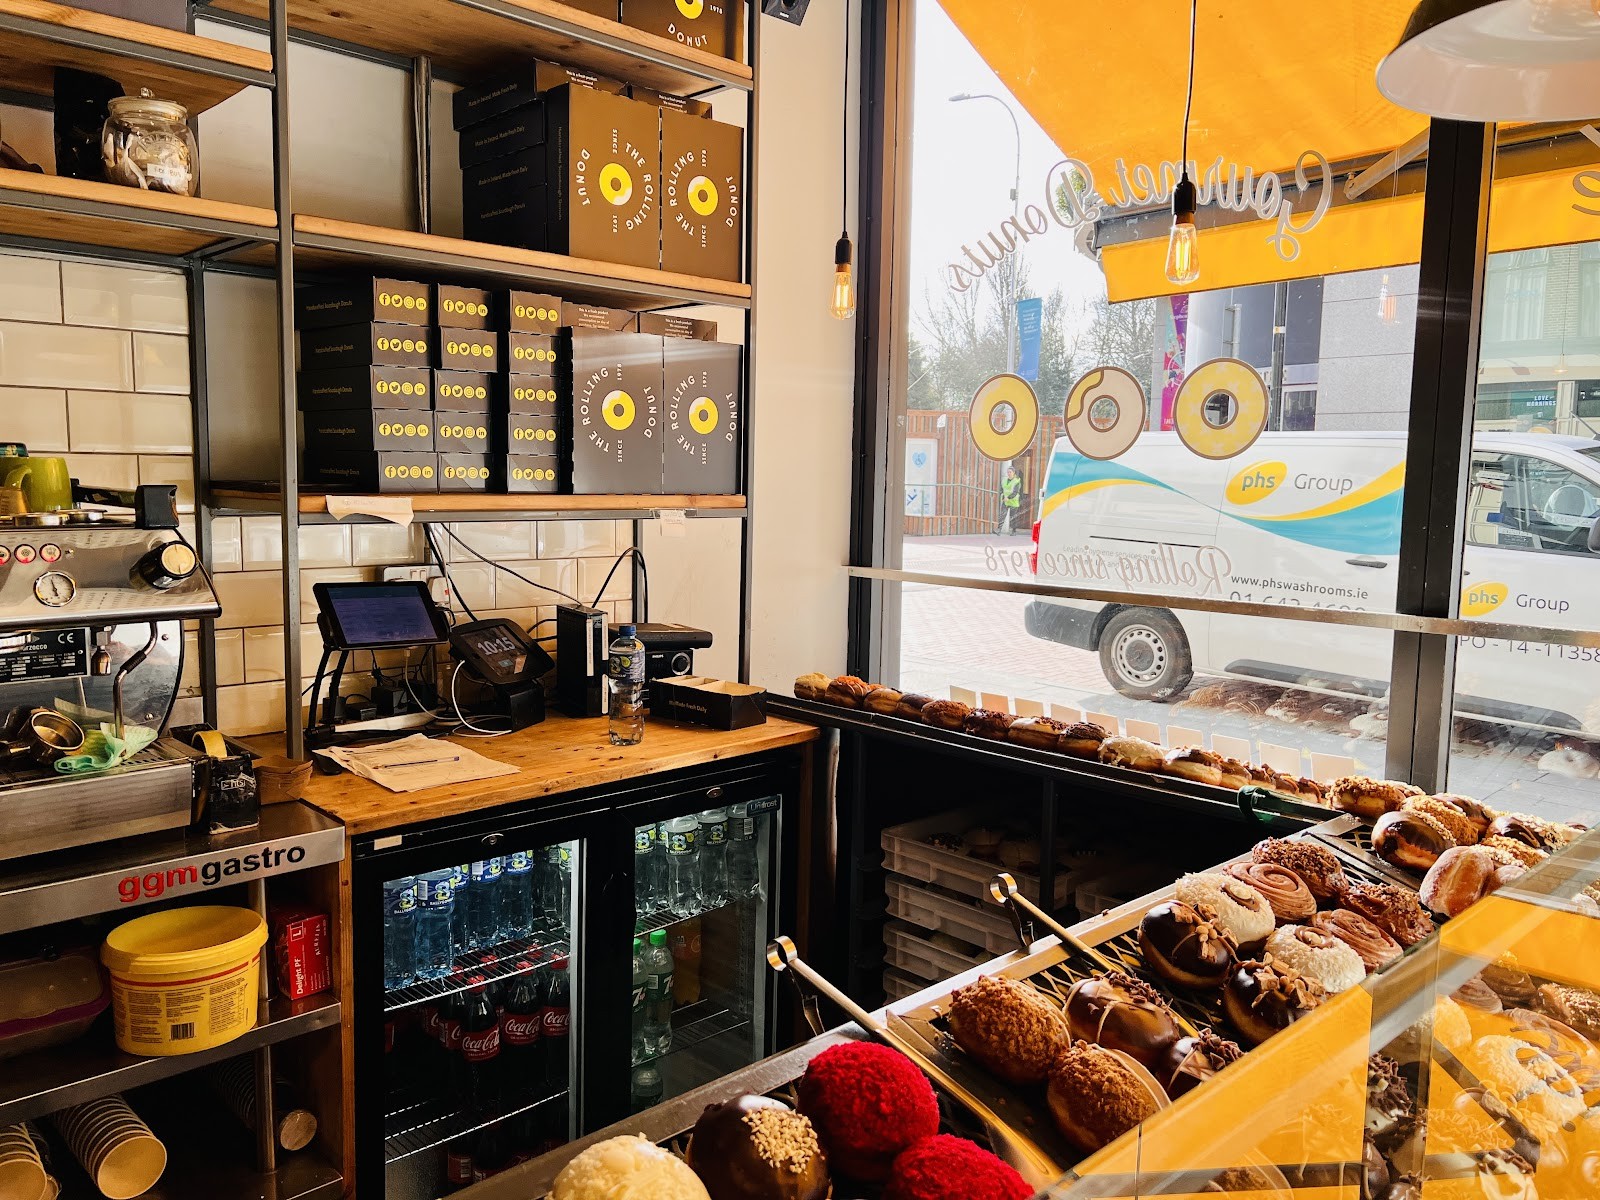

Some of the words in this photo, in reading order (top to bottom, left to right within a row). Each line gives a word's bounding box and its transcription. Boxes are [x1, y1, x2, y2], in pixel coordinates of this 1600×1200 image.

[710, 4, 723, 15] 1978
[667, 23, 708, 47] DONUT
[625, 142, 645, 167] THE
[575, 148, 591, 205] DONUT
[668, 151, 695, 207] ROLLING
[626, 173, 654, 231] ROLLING
[725, 176, 738, 228] DONUT
[675, 213, 695, 236] THE
[580, 367, 609, 426] ROLLING
[669, 375, 696, 430] ROLLING
[643, 386, 657, 438] DONUT
[725, 392, 738, 442] DONUT
[589, 431, 610, 452] THE
[677, 435, 696, 455] THE
[1242, 471, 1275, 491] phs
[1294, 473, 1353, 495] Group
[1231, 576, 1368, 599] www.phswashrooms.ie
[1468, 590, 1498, 605] phs
[1516, 594, 1569, 614] Group
[477, 636, 516, 655] 10:15
[697, 704, 707, 714] Daily
[293, 929, 301, 937] L
[294, 958, 301, 967] PF
[295, 969, 304, 994] Delight
[543, 1011, 571, 1027] Coca-C
